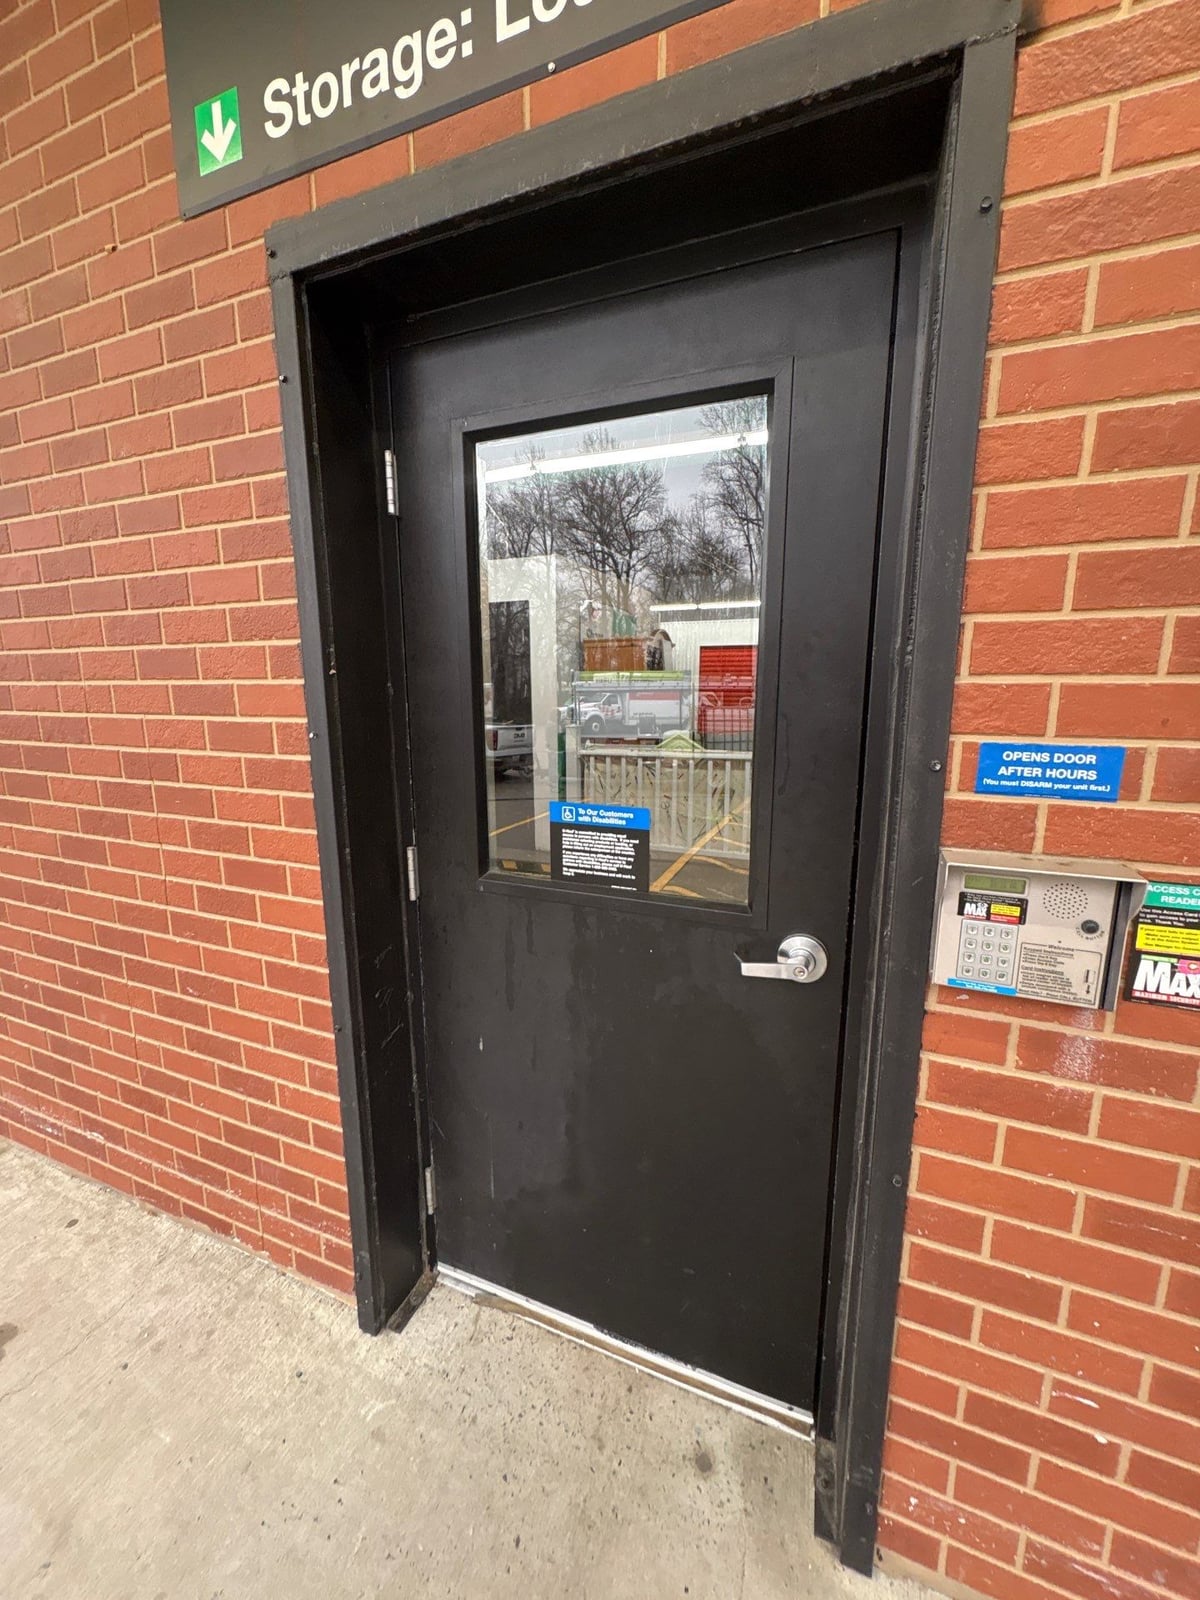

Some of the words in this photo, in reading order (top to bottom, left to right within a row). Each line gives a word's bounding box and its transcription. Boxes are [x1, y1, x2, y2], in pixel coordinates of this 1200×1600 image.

[262, 8, 474, 140] Storage:
[496, 0, 593, 43] Lo
[1002, 751, 1050, 763] OPENS
[1053, 753, 1097, 765] DOOR
[997, 766, 1042, 778] AFTER
[1045, 768, 1098, 780] HOURS
[1020, 780, 1052, 789] DISARM
[1053, 783, 1071, 791] your
[599, 809, 634, 819] Customers
[592, 816, 626, 826] Disabilities
[1147, 884, 1190, 895] ACCESS
[1161, 895, 1200, 905] READE
[964, 902, 988, 917] MAX
